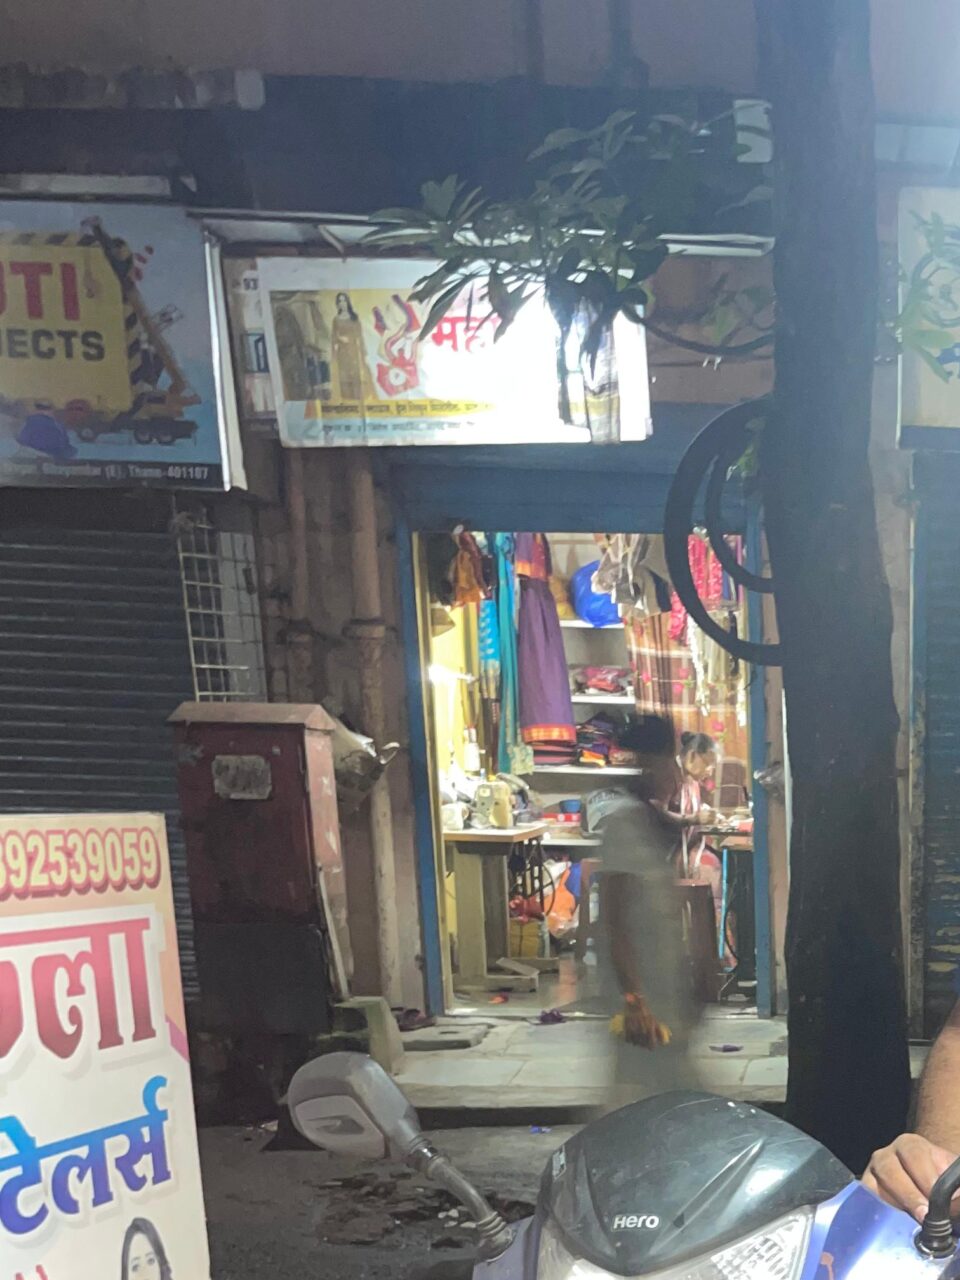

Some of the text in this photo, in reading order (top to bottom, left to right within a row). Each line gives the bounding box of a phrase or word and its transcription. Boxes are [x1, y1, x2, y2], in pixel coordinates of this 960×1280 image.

[0, 258, 81, 321] TI
[0, 327, 105, 361] ECTS
[0, 826, 161, 899] 92539059
